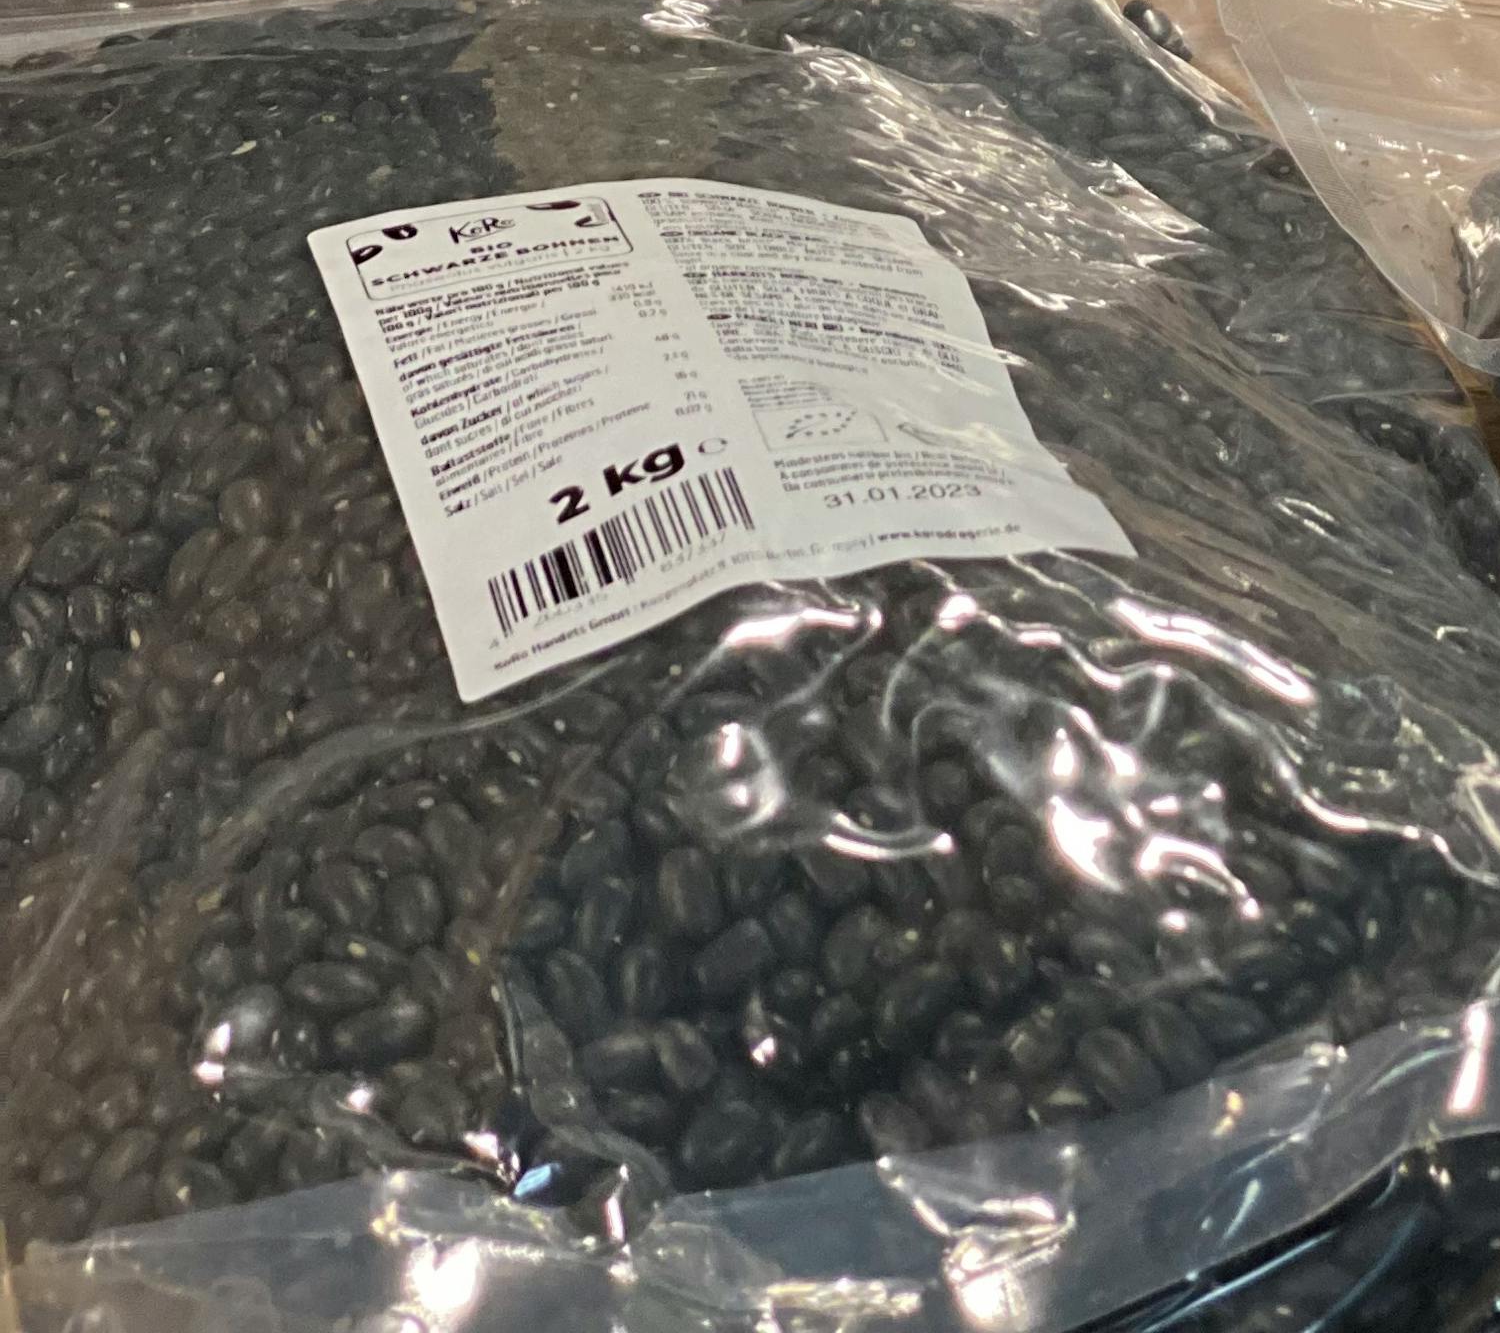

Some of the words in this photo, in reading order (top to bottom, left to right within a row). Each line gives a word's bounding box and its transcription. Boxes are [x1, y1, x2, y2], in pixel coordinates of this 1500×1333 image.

[449, 217, 516, 243] KoRo
[371, 252, 509, 285] SCHWARZE
[516, 235, 619, 255] BOHNEN
[470, 242, 513, 254] BIO
[549, 485, 591, 524] 2
[603, 443, 686, 497] kg
[824, 483, 982, 509] 31.01.2023
[877, 523, 1021, 543] www.korodrogerie.de
